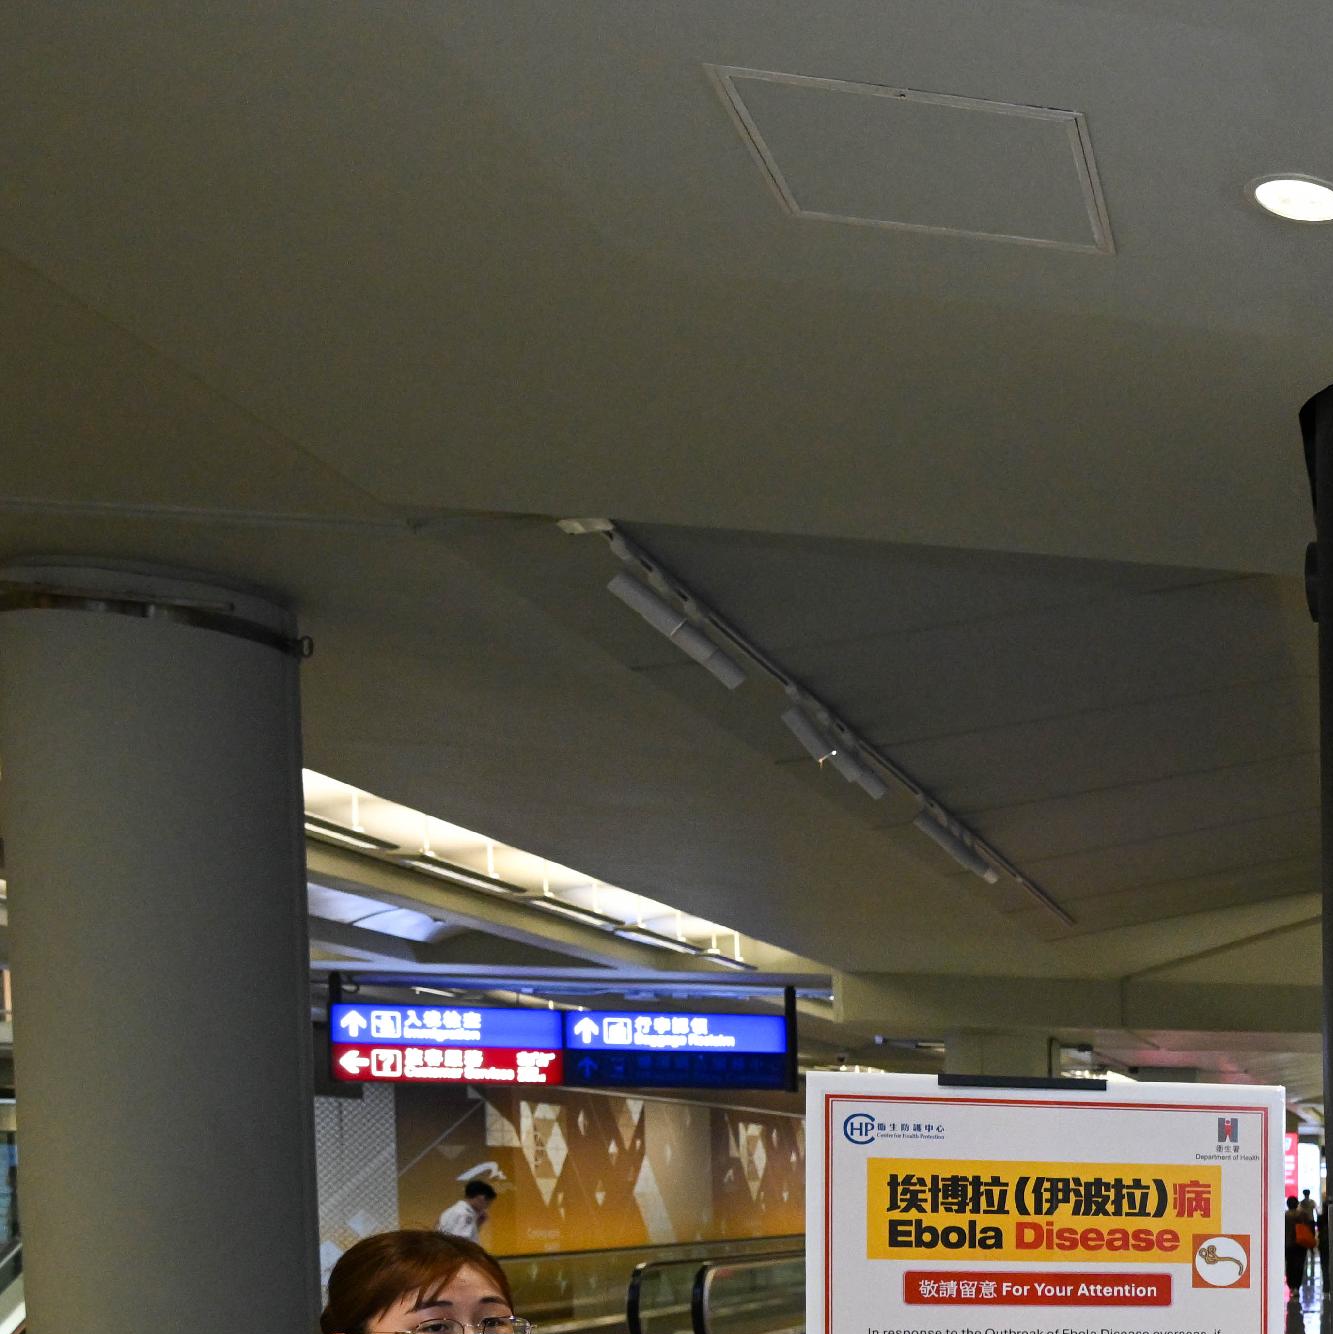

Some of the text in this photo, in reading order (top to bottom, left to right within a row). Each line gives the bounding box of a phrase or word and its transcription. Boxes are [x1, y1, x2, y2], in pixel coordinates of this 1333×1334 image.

[888, 1218, 1180, 1252] Ebola Disease
[918, 1280, 998, 1299] 敬請留意
[1002, 1282, 1157, 1299] For Your Attention
